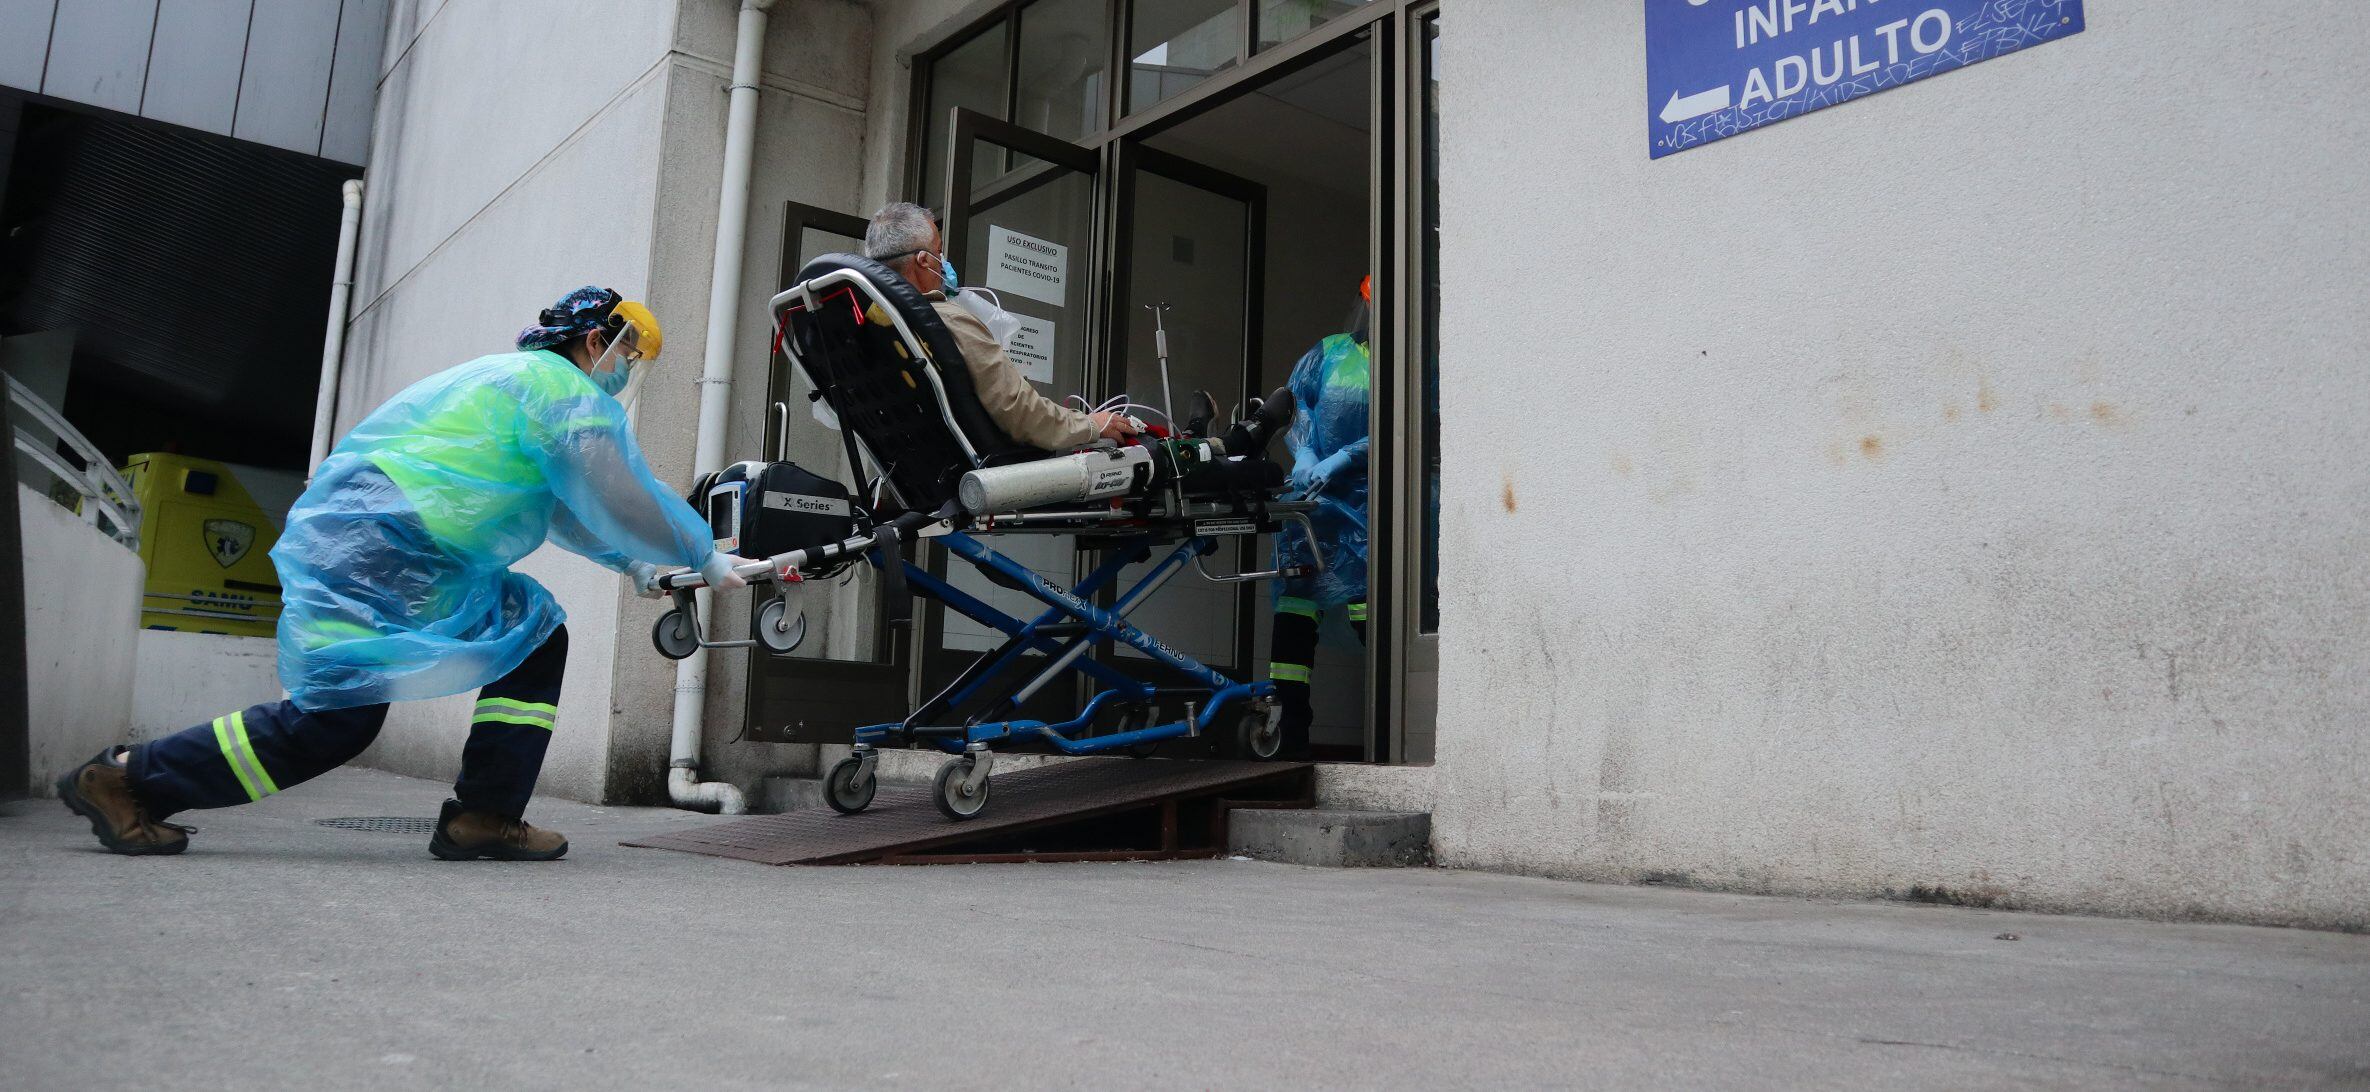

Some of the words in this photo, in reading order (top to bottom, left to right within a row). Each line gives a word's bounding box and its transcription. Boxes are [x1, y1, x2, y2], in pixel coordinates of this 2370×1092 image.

[1735, 0, 1879, 49] INFA
[1739, 8, 1952, 111] ADULTO
[1007, 235, 1021, 246] USO
[1023, 239, 1058, 257] EXCLUSIVO
[1000, 262, 1032, 277] PACIENTES
[1032, 271, 1060, 284] COVID-19
[1004, 252, 1028, 265] PASILLO
[1029, 259, 1058, 273] TRANSITO
[1009, 349, 1048, 361] RESPIRATORIOS
[783, 497, 792, 508] X
[796, 498, 830, 511] Series
[1151, 636, 1185, 662] FERNO
